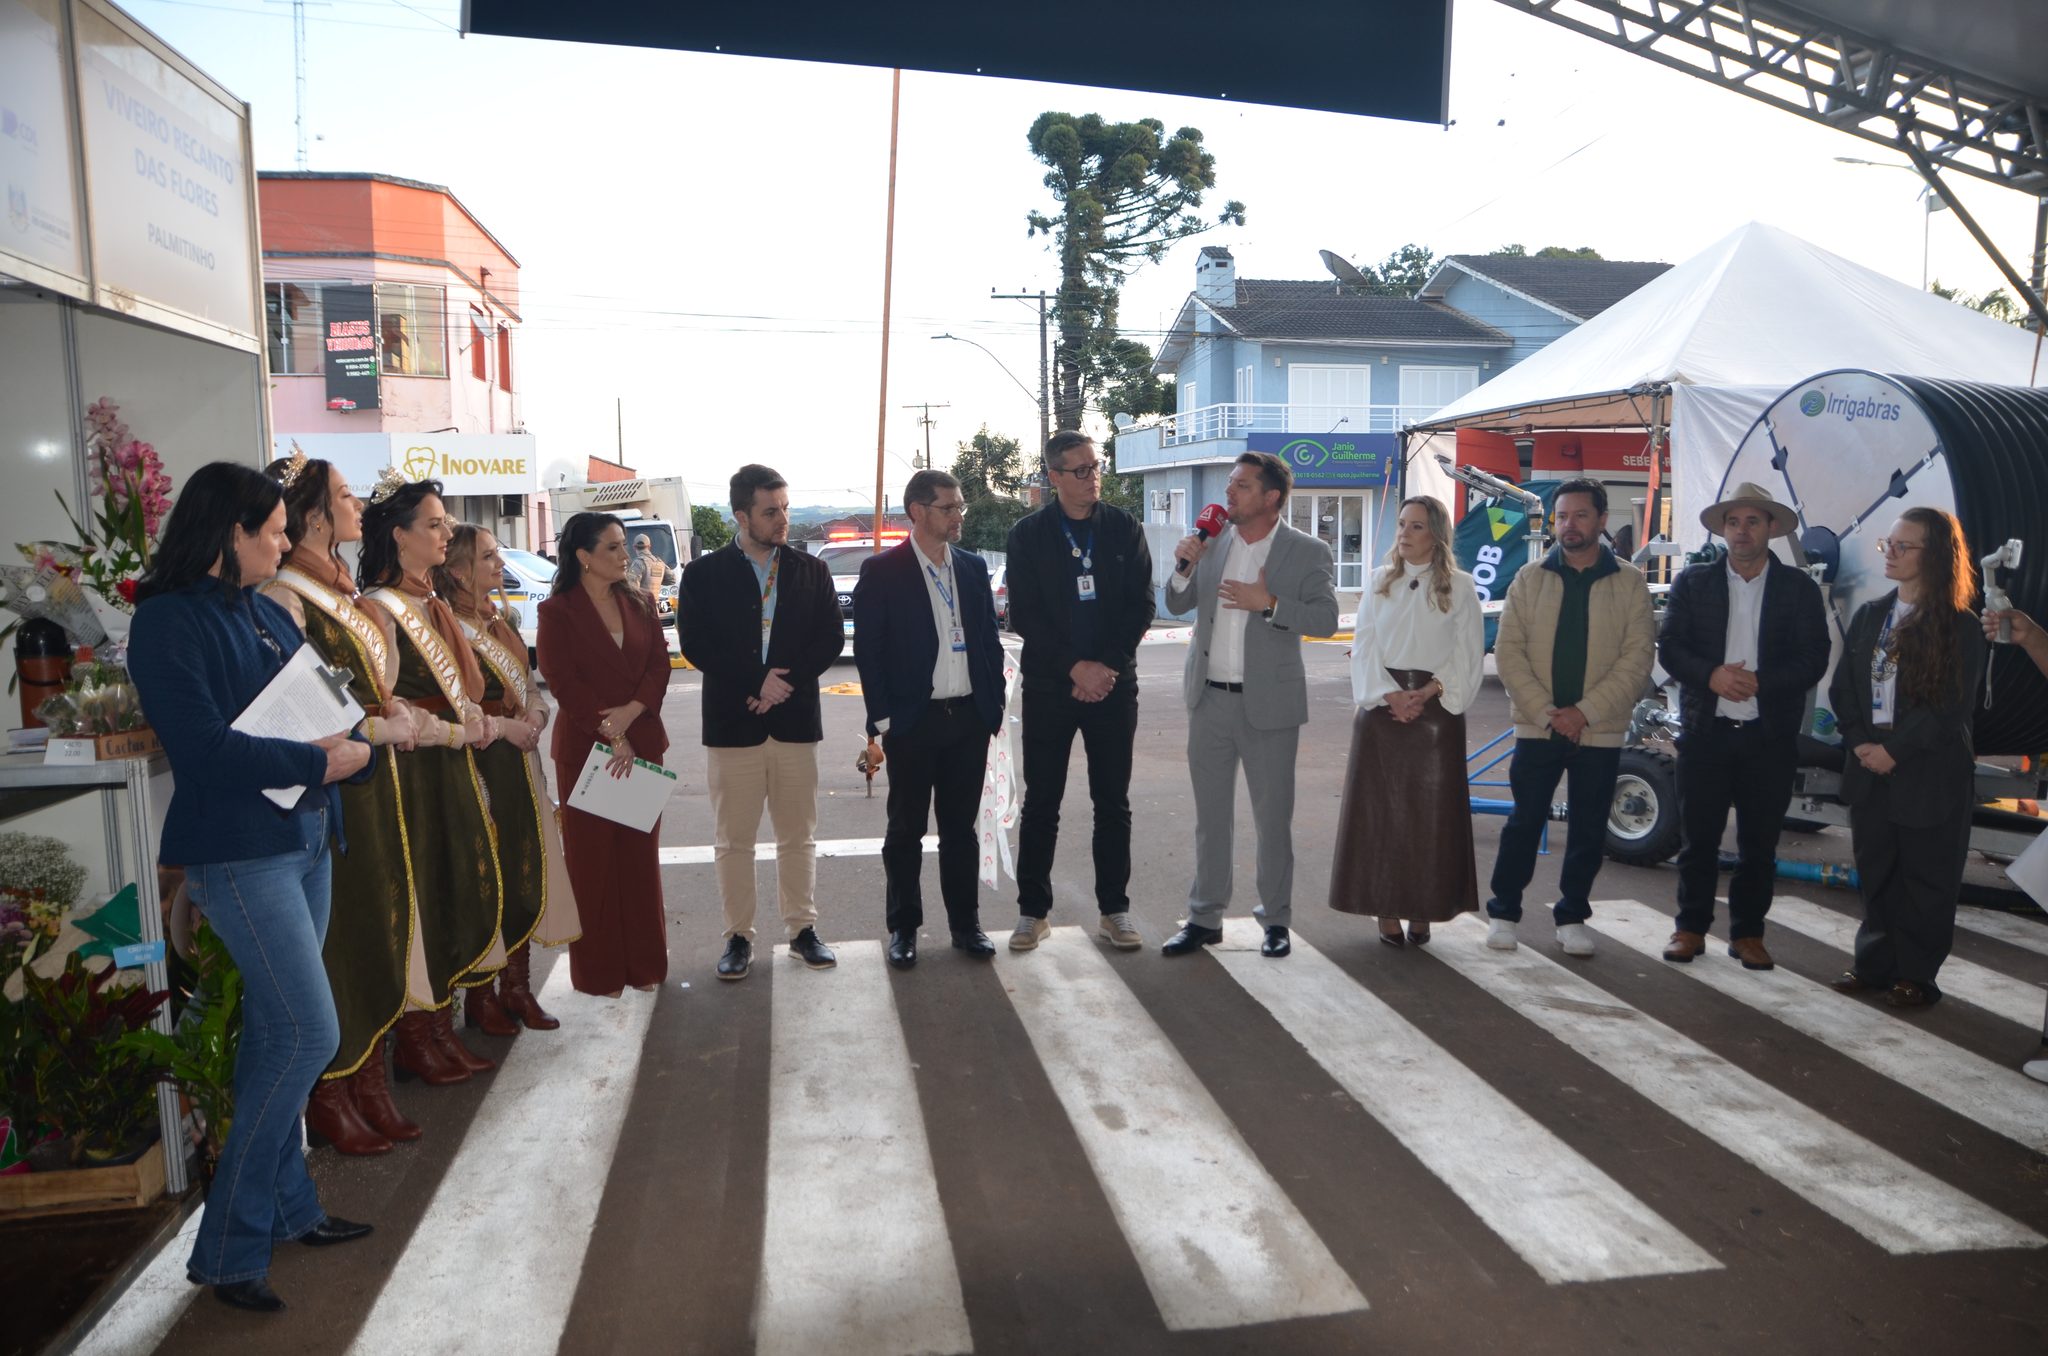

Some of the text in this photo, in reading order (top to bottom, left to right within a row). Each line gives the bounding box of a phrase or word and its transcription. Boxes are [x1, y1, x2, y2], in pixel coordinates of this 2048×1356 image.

[103, 80, 234, 185] VIVEIRO RECANTO
[135, 148, 219, 217] DAS FLORES
[148, 222, 215, 270] PALMITINHO
[1827, 392, 1900, 421] Irrigabras
[1331, 441, 1355, 451] Janio
[1331, 451, 1377, 461] Guilherme
[442, 453, 527, 476] INOVARE
[402, 605, 459, 689] RAINHA
[105, 737, 145, 756] Cactus
